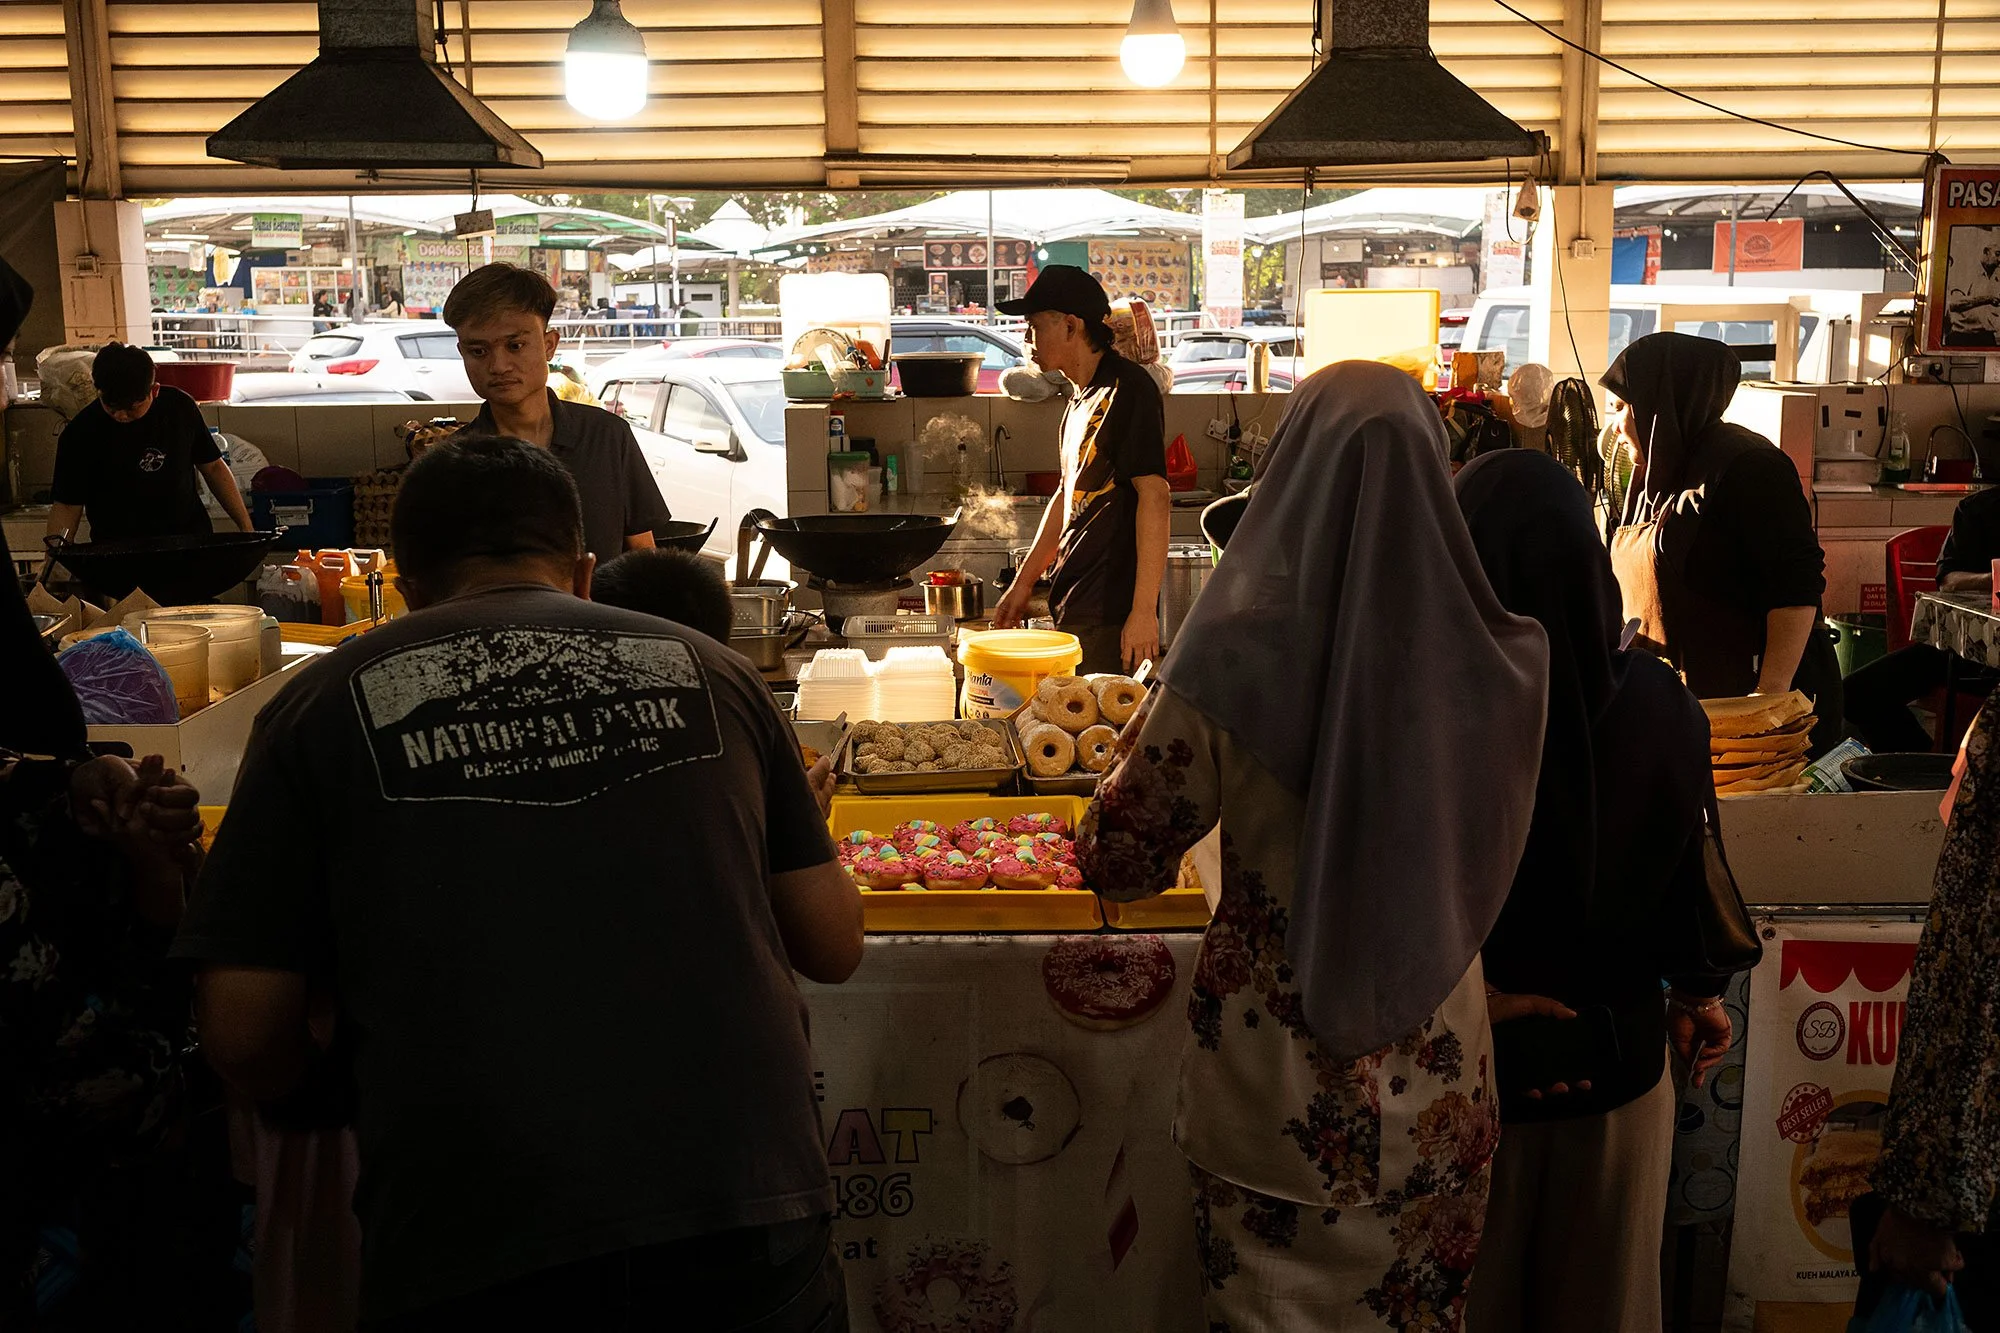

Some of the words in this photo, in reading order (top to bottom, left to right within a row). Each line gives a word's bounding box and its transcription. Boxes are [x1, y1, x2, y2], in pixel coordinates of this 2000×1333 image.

[418, 243, 462, 257] DAMAS
[1803, 1019, 1838, 1039] SB
[1782, 1110, 1802, 1132] BEST
[1800, 1095, 1828, 1119] SELLER
[835, 1236, 878, 1260] at
[1796, 1270, 1818, 1280] KUEH
[1819, 1269, 1850, 1279] MALAYA
